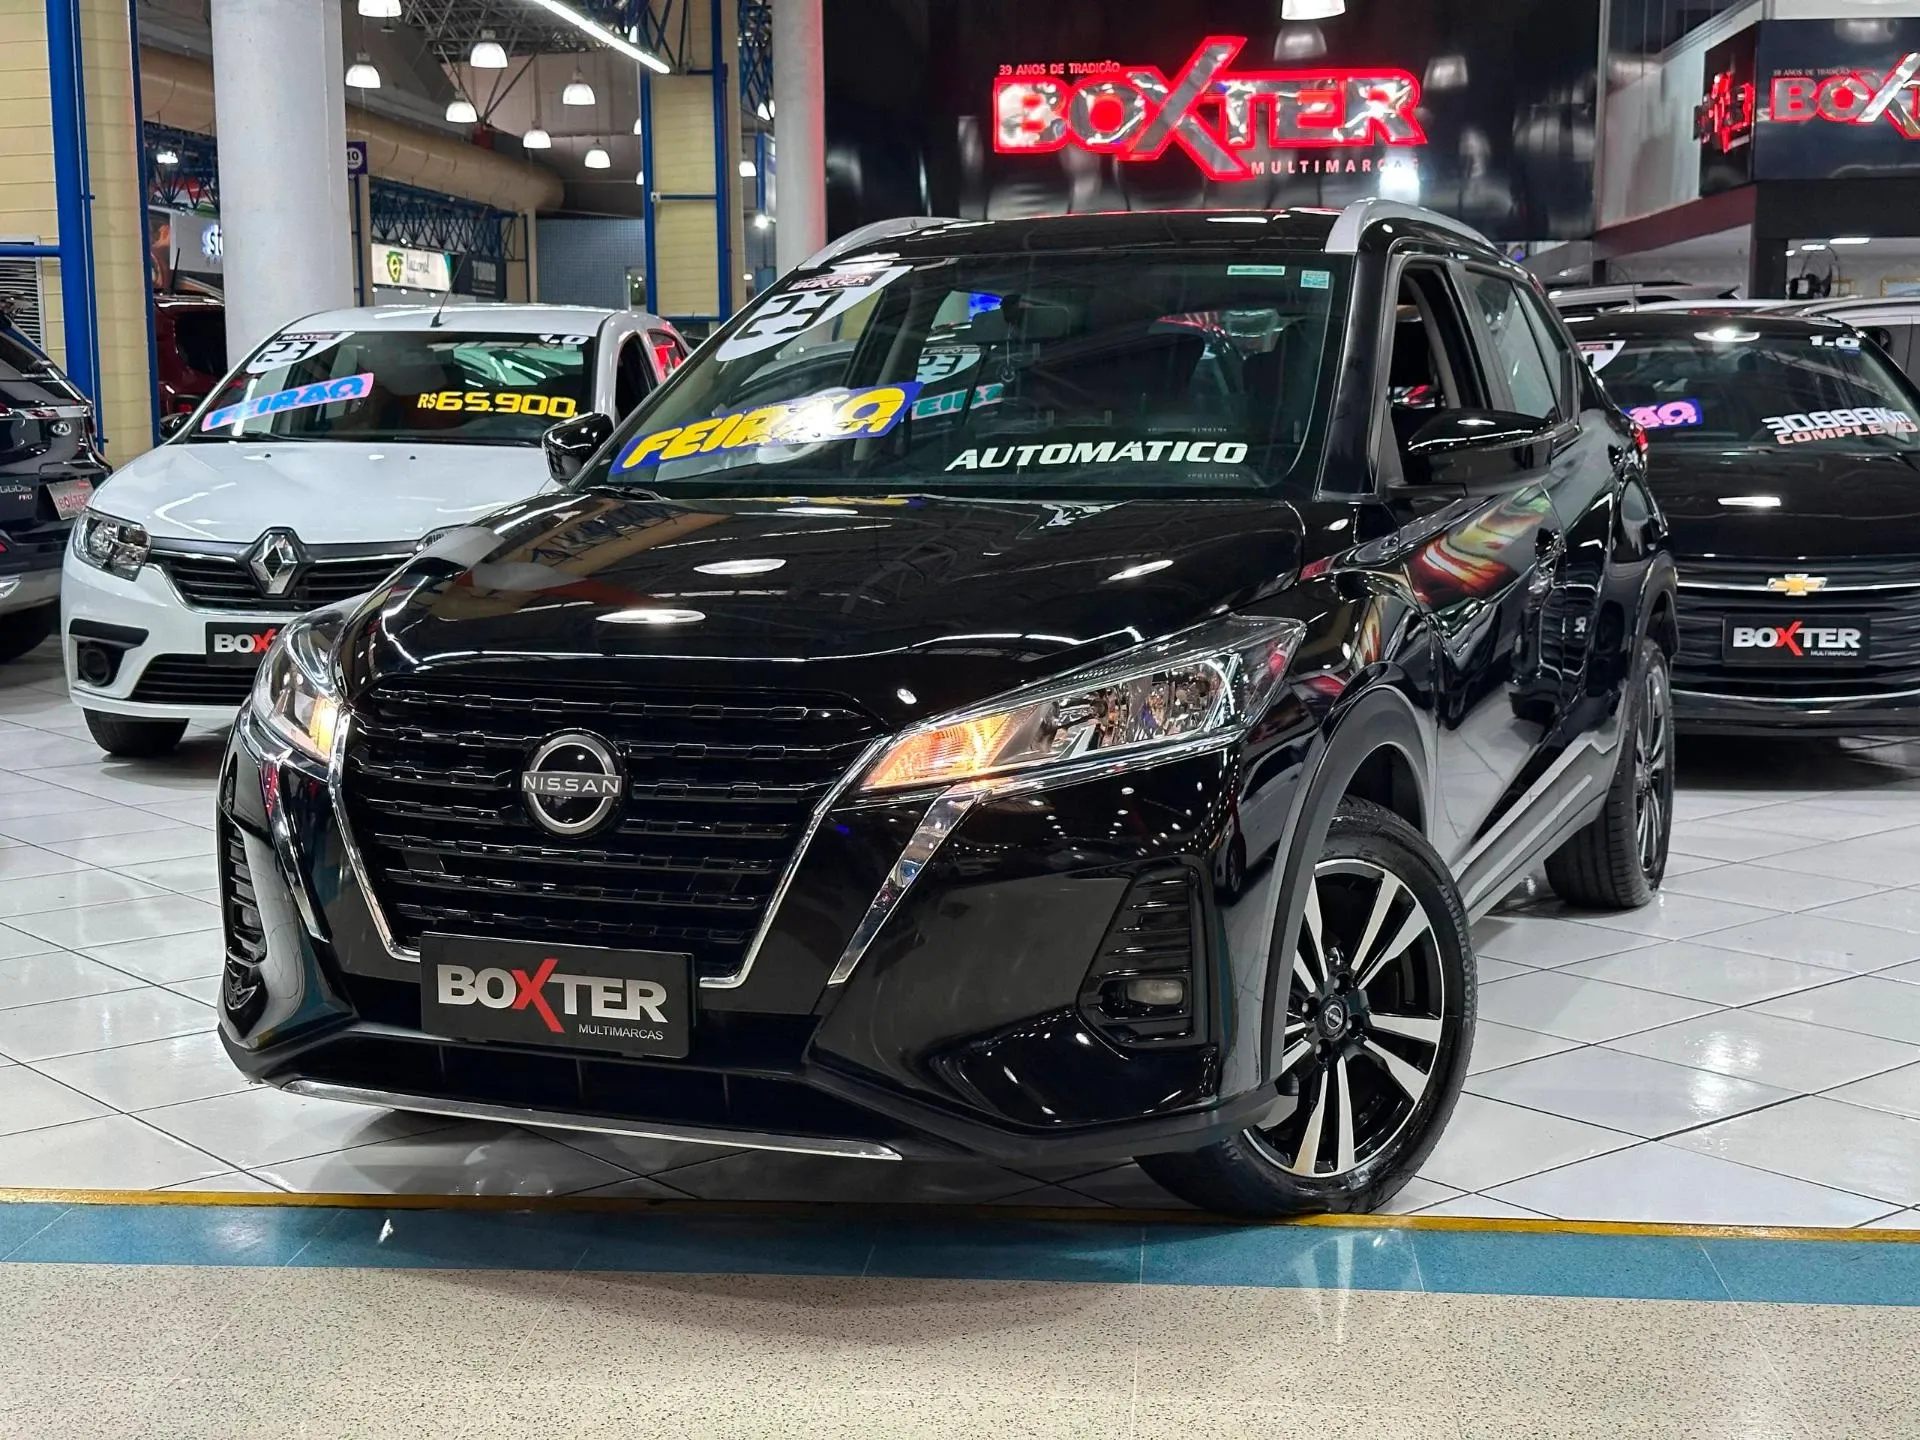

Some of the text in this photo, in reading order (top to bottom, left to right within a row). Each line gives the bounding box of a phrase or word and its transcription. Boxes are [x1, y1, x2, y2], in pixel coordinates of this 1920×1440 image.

[999, 65, 1013, 76] 39
[1016, 64, 1046, 75] ANOS
[1050, 63, 1065, 75] DE
[993, 36, 1428, 181] BOXTER
[1250, 159, 1419, 175] MULTIMARCS
[733, 289, 845, 340] 23
[1810, 334, 1860, 347] 1.0
[214, 627, 277, 653] BOX
[1732, 620, 1862, 656] BOXTER
[523, 775, 619, 794] NISSAN
[437, 957, 669, 1034] BOXTER
[578, 1023, 664, 1041] MULTIMARCAS
